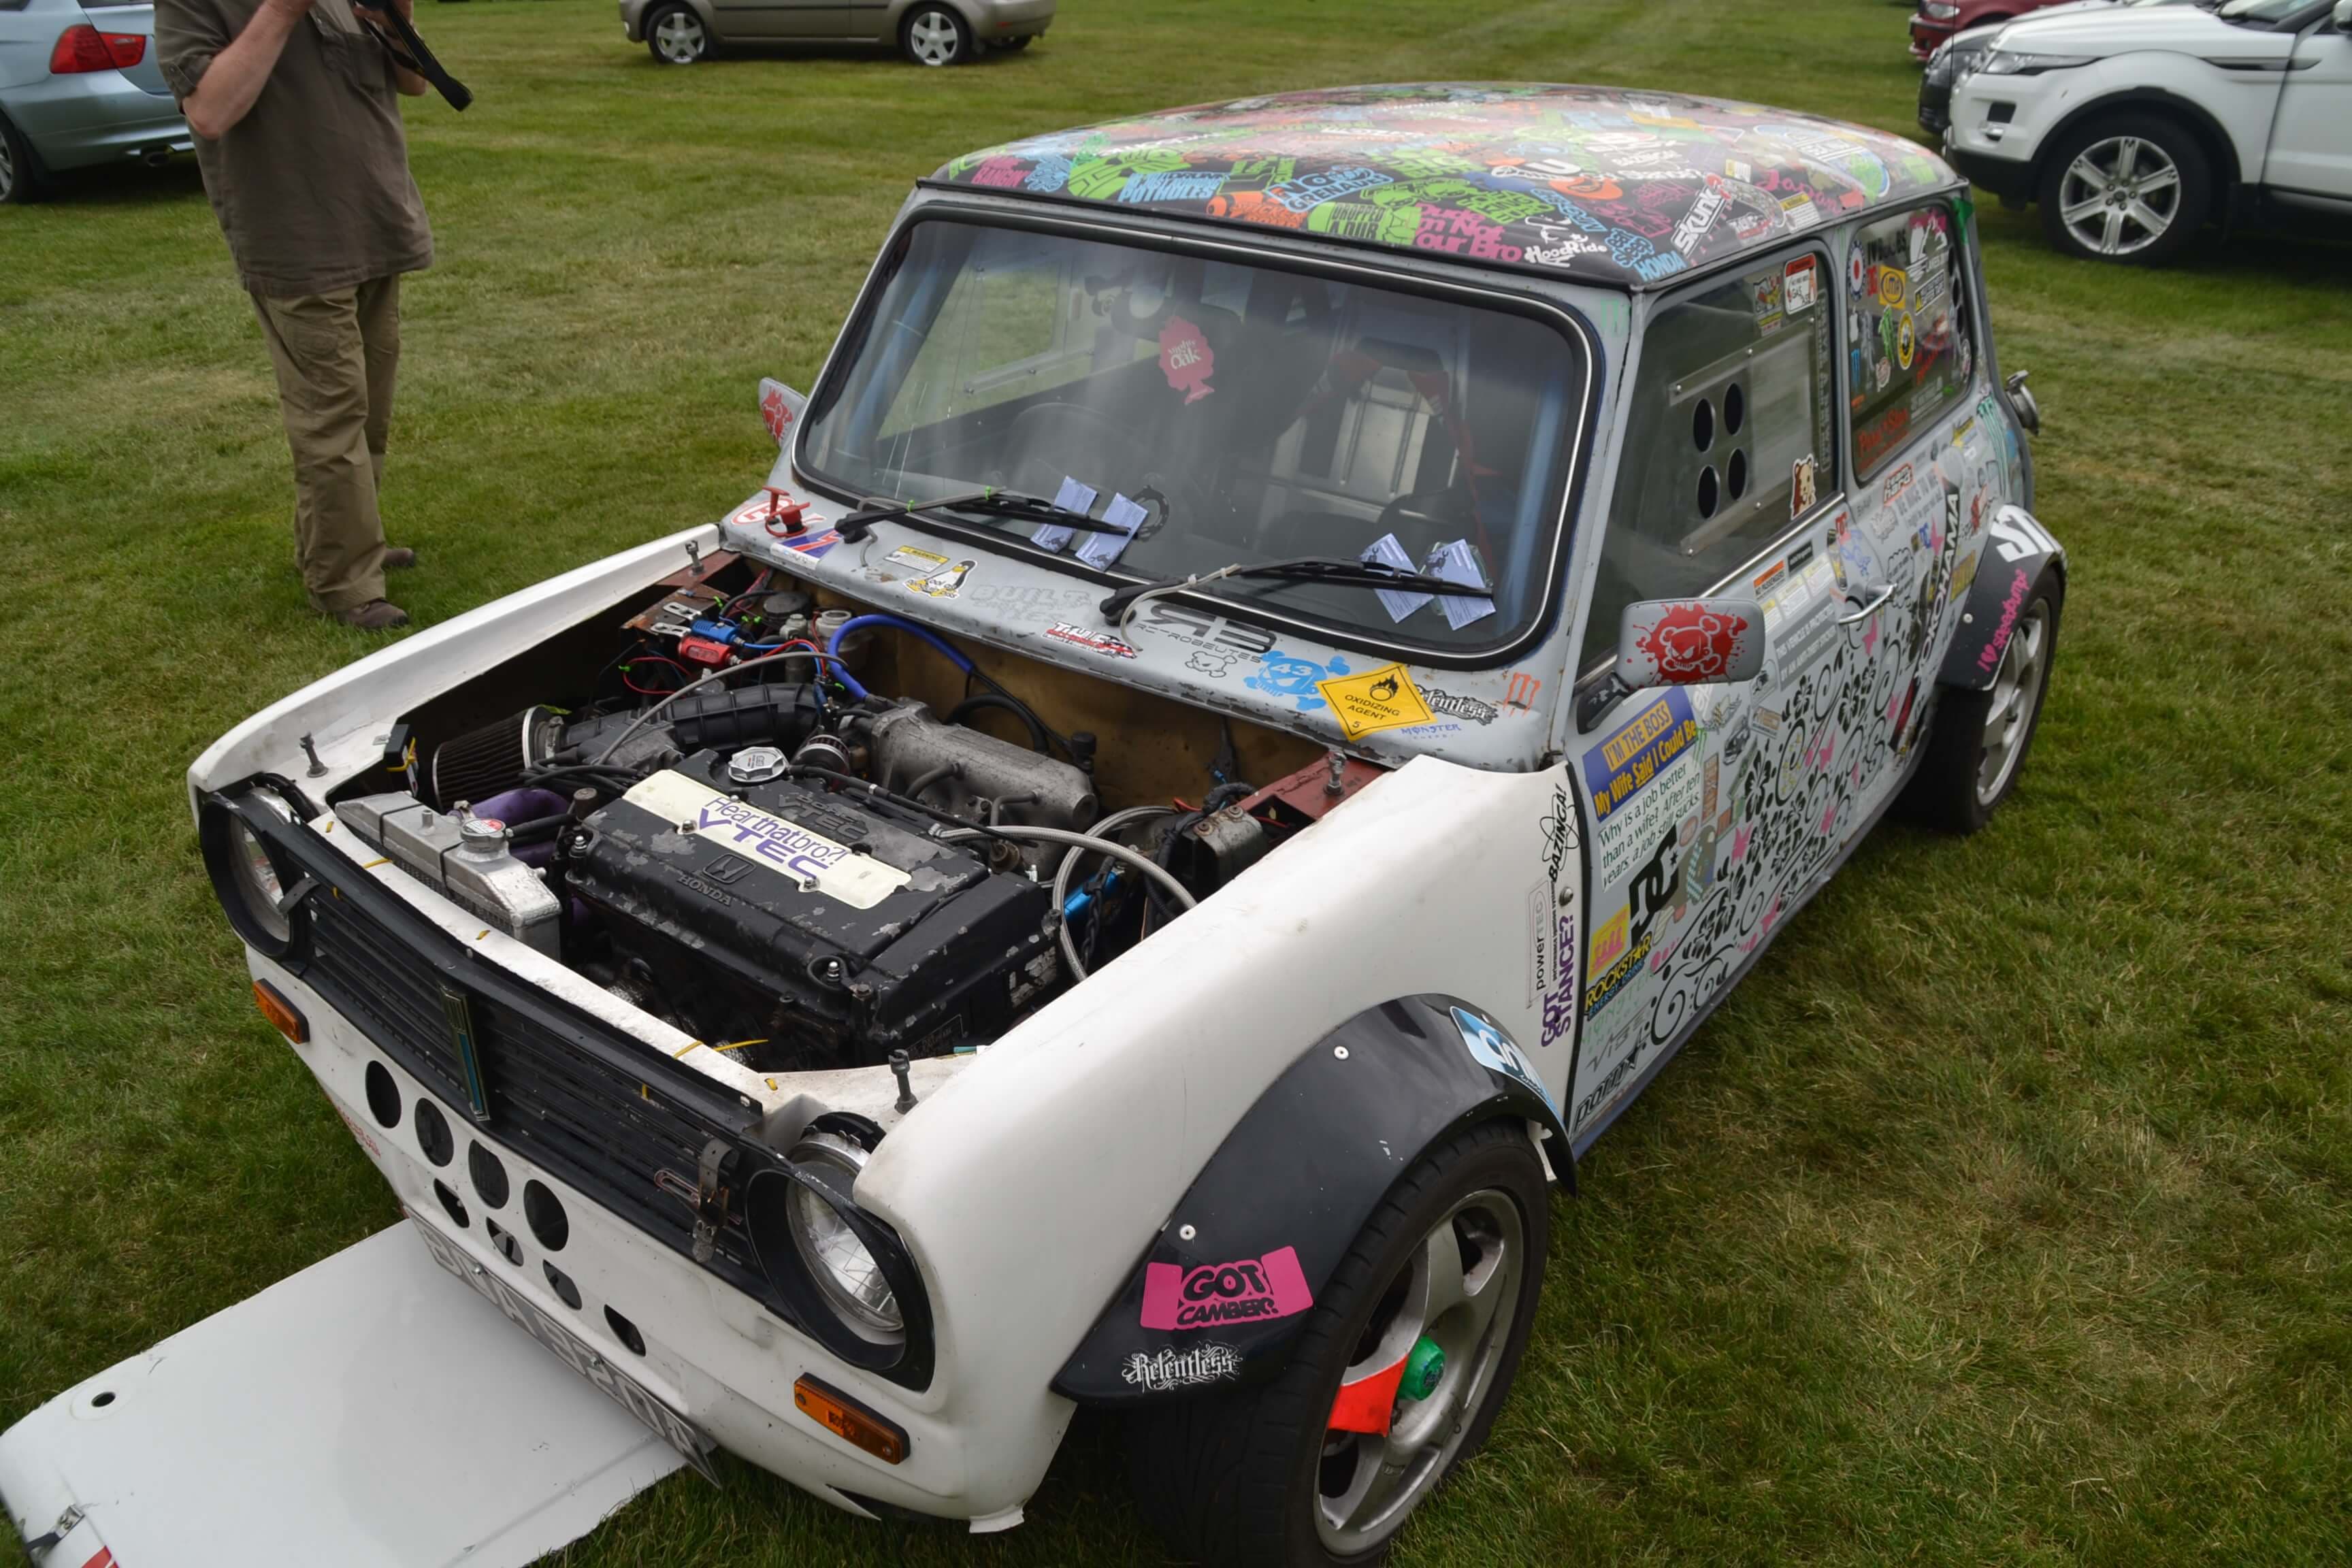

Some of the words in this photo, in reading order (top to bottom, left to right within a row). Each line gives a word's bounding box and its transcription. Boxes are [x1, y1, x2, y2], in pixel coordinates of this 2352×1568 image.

[1469, 238, 1522, 262] Bro
[1634, 250, 1687, 282] HONDA
[1914, 494, 1961, 679] YOKOHAMA
[1271, 663, 1313, 676] 43
[1345, 694, 1400, 717] OXIDIZING
[1346, 704, 1387, 721] AGENT
[1352, 720, 1362, 729] 5
[1605, 744, 1624, 767] I'M
[1622, 724, 1646, 753] THE
[1643, 704, 1670, 737] BOSS
[1594, 790, 1611, 817] My
[1610, 772, 1634, 803] Wife
[1632, 753, 1654, 788] Said
[1652, 747, 1660, 768] I
[1659, 726, 1685, 762] Could
[1682, 719, 1697, 741] Be
[706, 797, 754, 824] Hear
[754, 815, 795, 846] that
[793, 832, 848, 865] bro?!
[1548, 783, 1567, 883] BAZINGA!
[1599, 821, 1623, 848] Why
[1624, 812, 1633, 828] is
[1634, 804, 1641, 817] a
[1639, 788, 1659, 813] job
[1659, 763, 1687, 795] better
[1603, 840, 1625, 869] than
[1627, 836, 1634, 848] a
[1634, 806, 1659, 841] wife?
[1663, 786, 1685, 814] After
[1684, 772, 1701, 794] ten
[698, 807, 830, 880] VTEC
[1603, 856, 1630, 889] years
[1632, 848, 1639, 863] a
[1637, 832, 1656, 860] job
[1656, 815, 1676, 839] still
[1675, 791, 1701, 821] sucks
[677, 875, 732, 906] HONDA
[1541, 992, 1559, 1047] GOT
[1555, 914, 1574, 1038] STANCE?
[1585, 931, 1652, 1012] ROCKSTAR
[1183, 1264, 1267, 1301] GOT
[1123, 1339, 1243, 1393] Relentless
